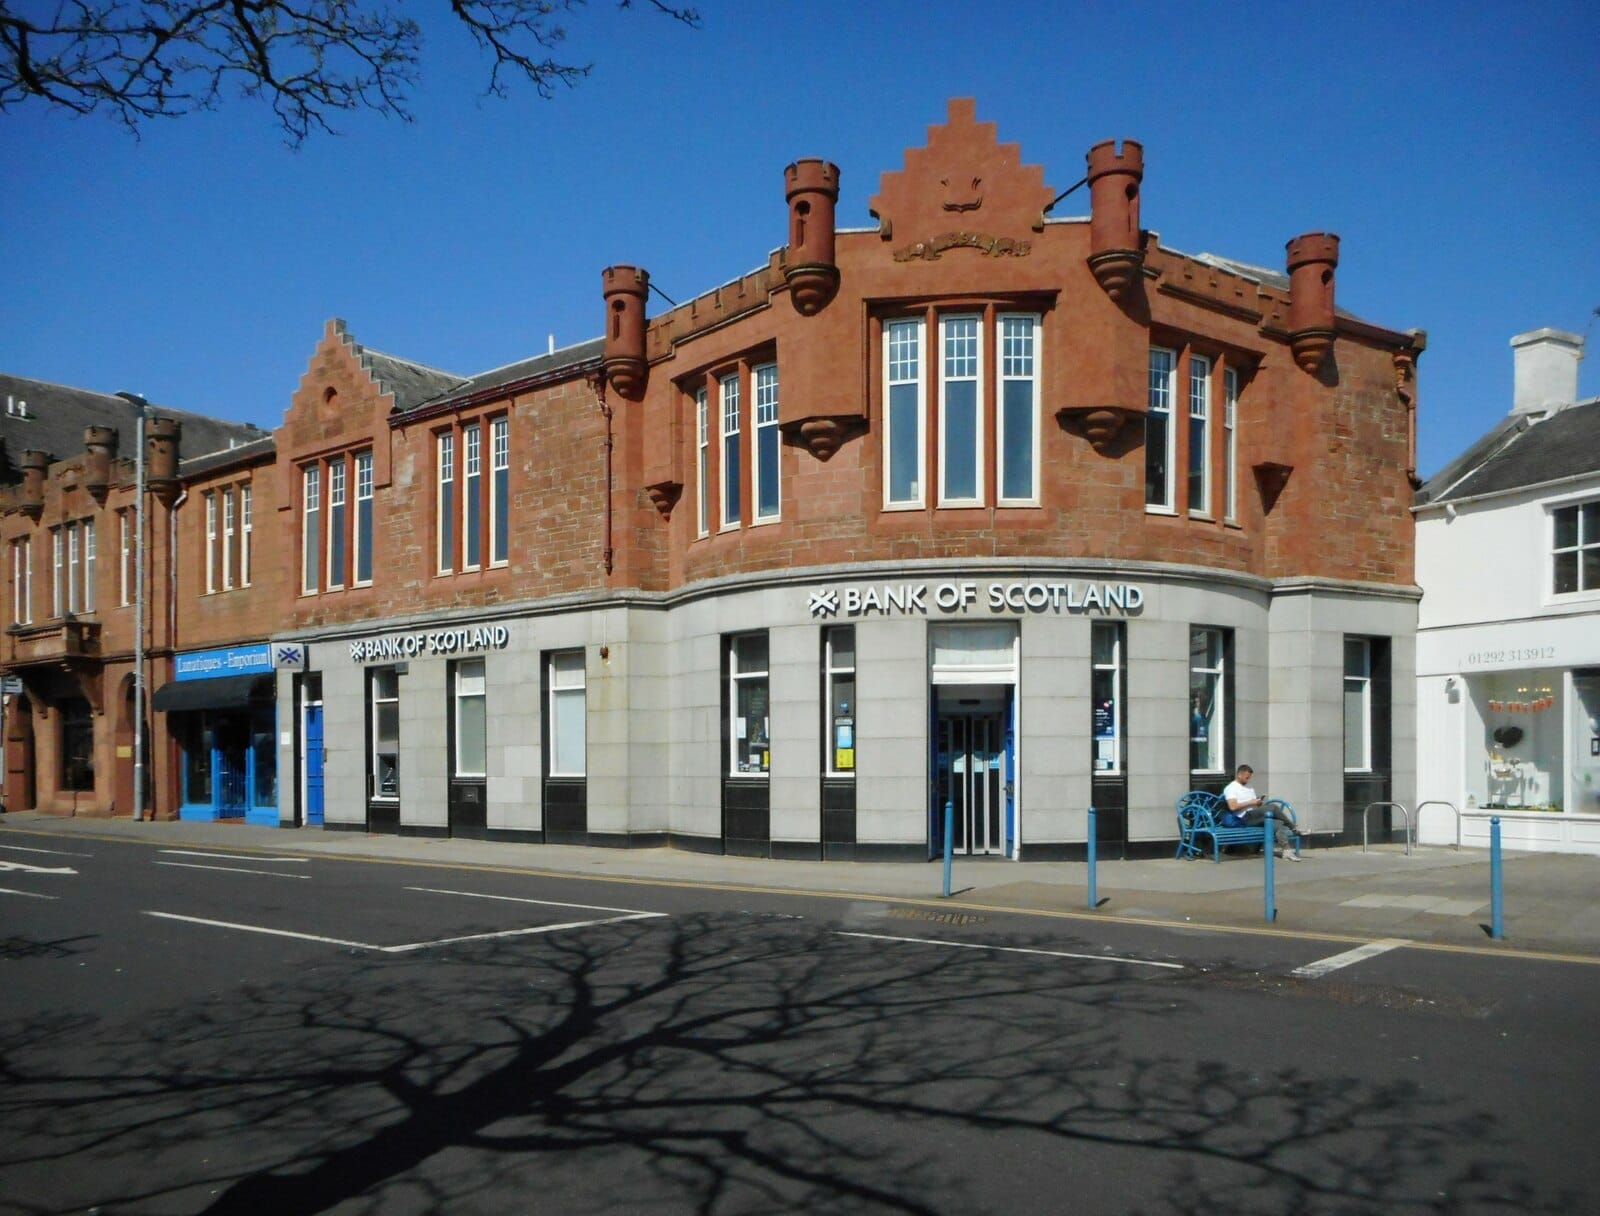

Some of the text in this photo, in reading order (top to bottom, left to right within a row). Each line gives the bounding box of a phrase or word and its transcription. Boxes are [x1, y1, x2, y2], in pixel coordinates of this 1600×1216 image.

[845, 583, 1144, 612] BANK OF SCOTLAND
[366, 627, 507, 658] BANK OF SCOTLAND
[1468, 647, 1555, 665] 01292 313912
